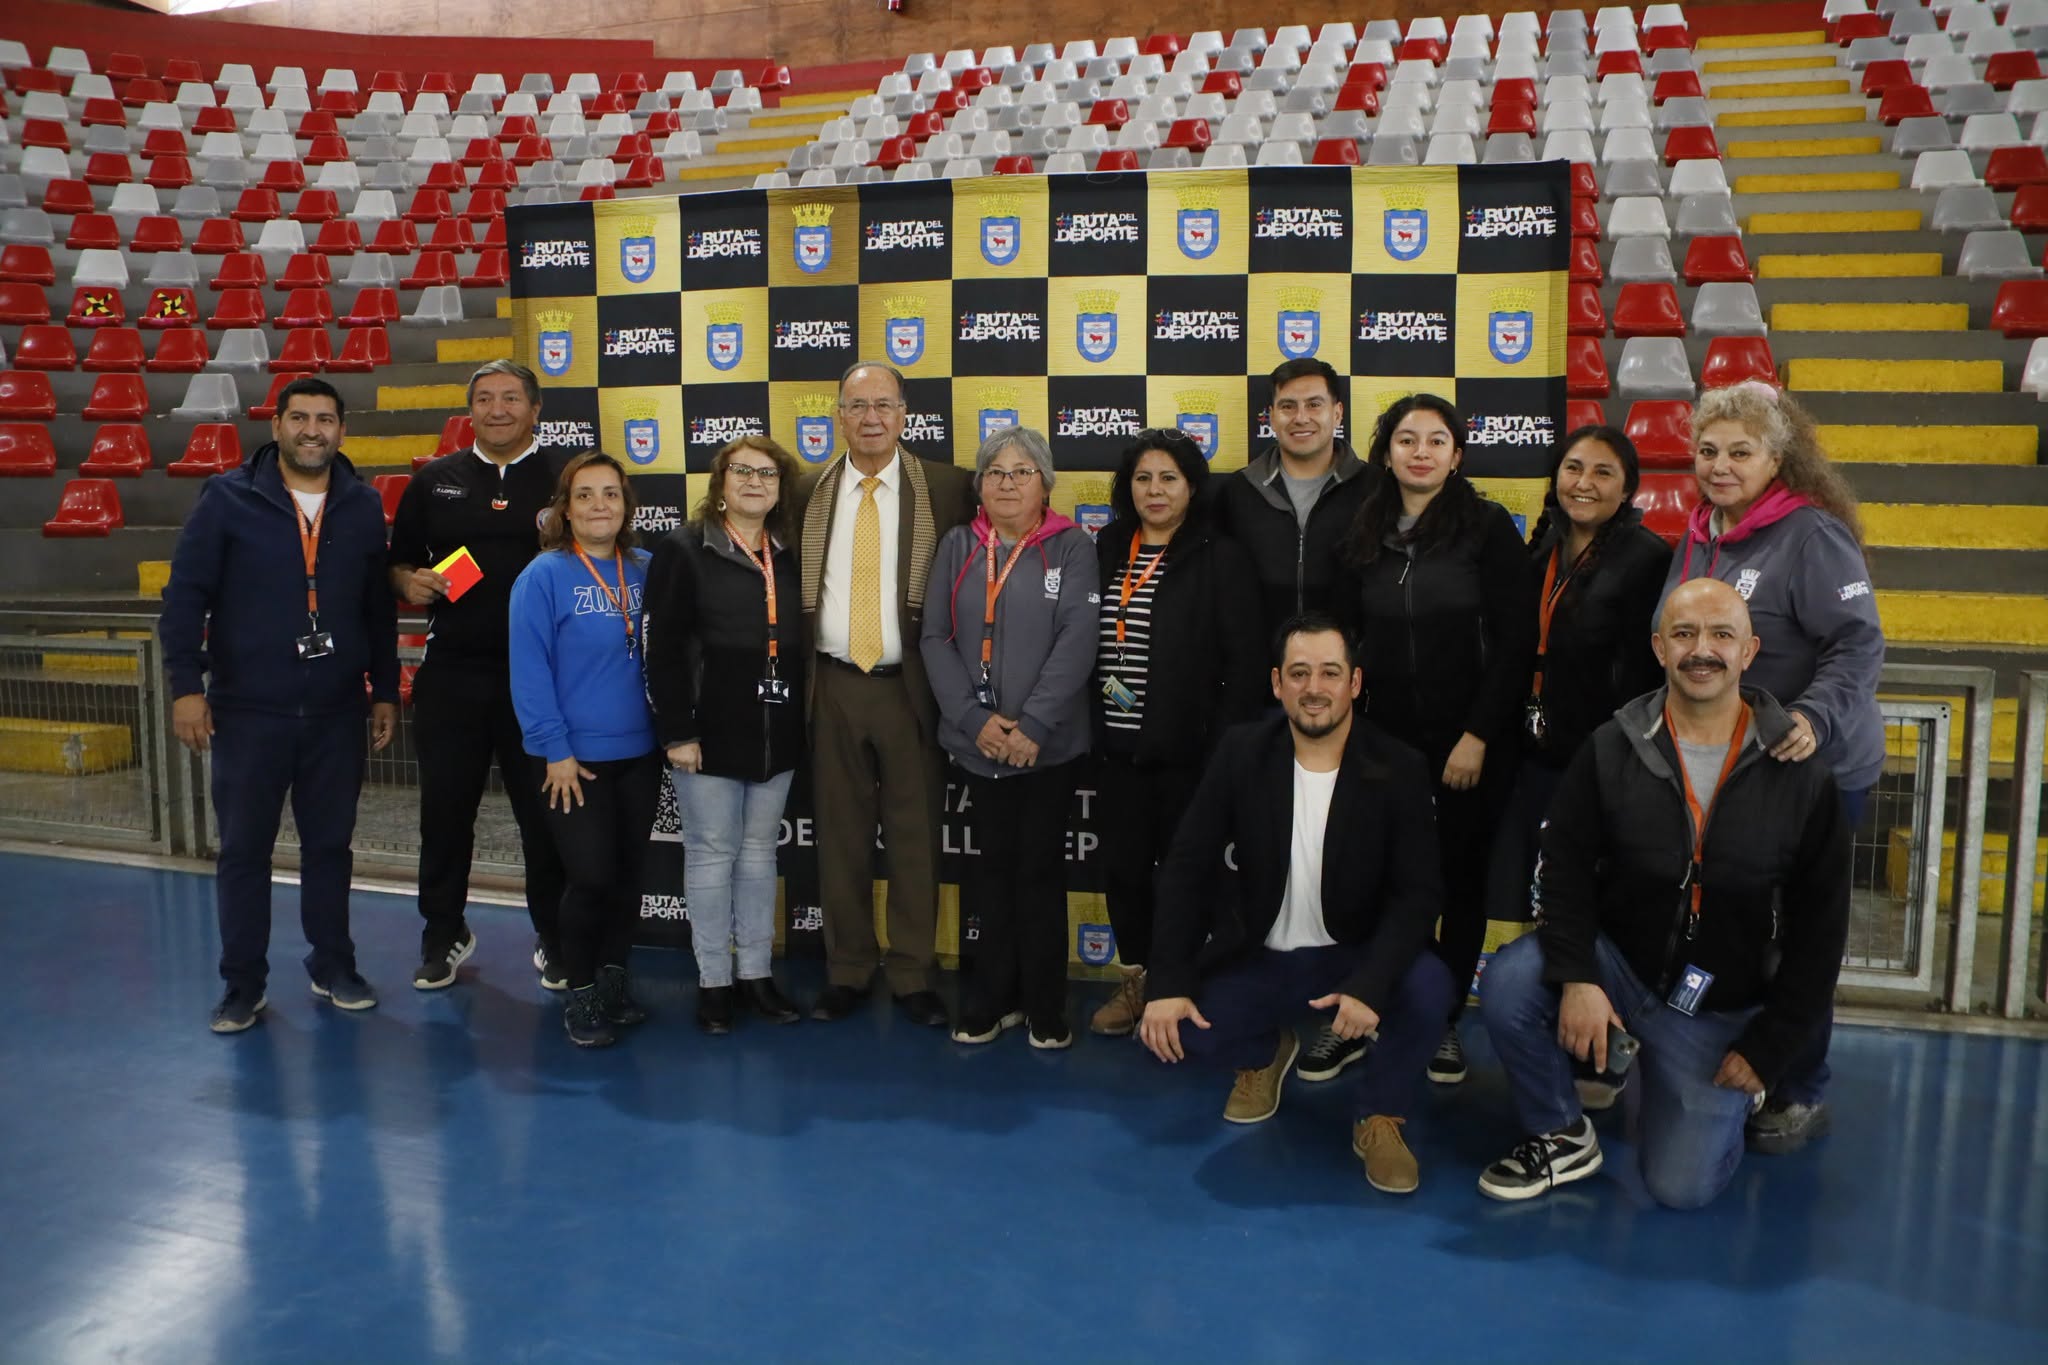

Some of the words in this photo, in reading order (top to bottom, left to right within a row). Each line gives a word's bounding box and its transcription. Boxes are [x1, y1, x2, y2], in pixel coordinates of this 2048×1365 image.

[1323, 209, 1342, 217] DEL
[1536, 206, 1555, 214] DEL
[1119, 213, 1138, 221] DEL
[926, 220, 943, 228] DEL
[1255, 221, 1342, 239] DEPORTE
[1465, 219, 1556, 239] DEPORTE
[743, 229, 760, 237] DEL
[1055, 225, 1139, 243] DEPORTE
[573, 240, 589, 248] DEL
[865, 232, 944, 251] DEPORTE
[687, 241, 761, 259] DEPORTE
[520, 252, 590, 268] DEPORTE
[1021, 312, 1039, 320] DEL
[1220, 312, 1238, 320] DEL
[1426, 312, 1447, 320] DEL
[959, 325, 1040, 342] DEPORTE
[1154, 324, 1240, 341] DEPORTE
[1358, 324, 1448, 342] DEPORTE
[775, 333, 851, 350] DEPORTE
[604, 339, 675, 357] DEPORTE
[1120, 409, 1139, 417] DEL
[578, 421, 593, 429] DEL
[745, 417, 763, 425] DEL
[1535, 416, 1553, 424] DEL
[1056, 420, 1140, 438] DEPORTE
[1466, 429, 1555, 447] DEPORTE
